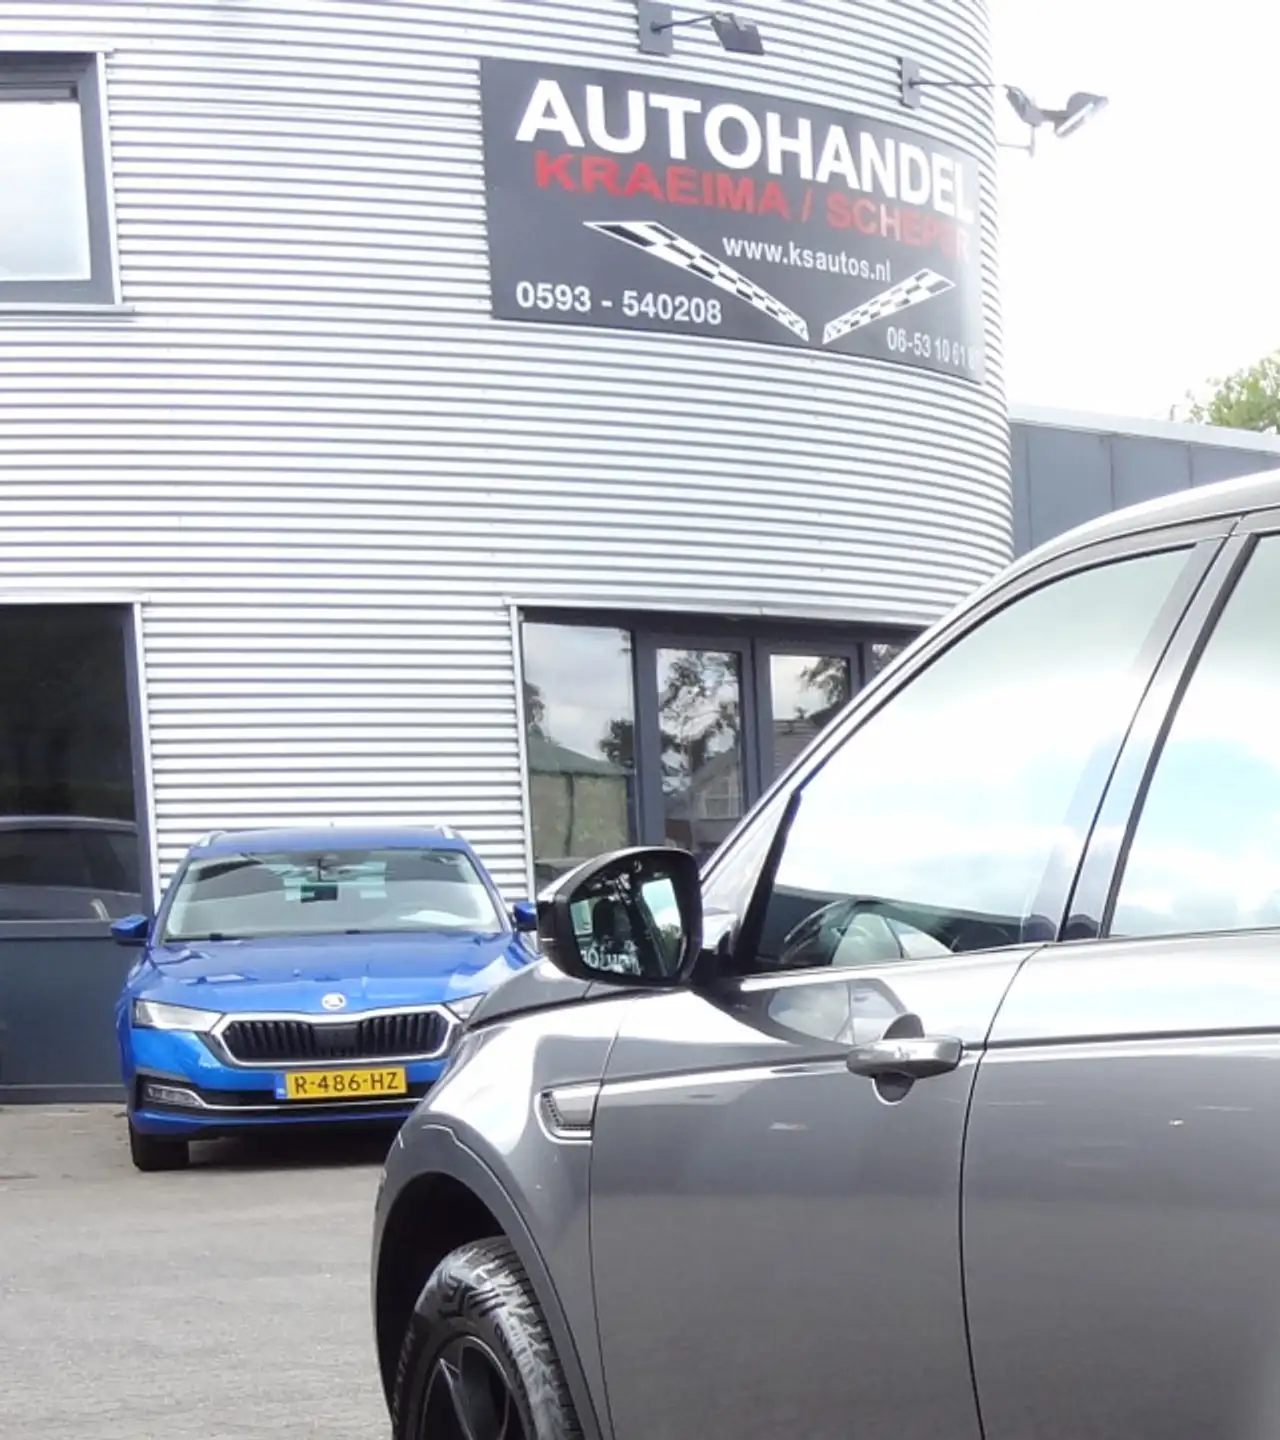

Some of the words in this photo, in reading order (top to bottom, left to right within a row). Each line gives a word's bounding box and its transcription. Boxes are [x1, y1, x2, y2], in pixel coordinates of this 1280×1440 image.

[515, 79, 974, 225] AUTOHANDEL
[534, 149, 790, 223] KRAEIMA
[802, 188, 815, 224] /
[722, 237, 892, 284] www.ksautos.nl
[515, 280, 592, 312] 0593
[622, 289, 723, 325] 540208
[886, 325, 932, 358] 06-53
[294, 1071, 400, 1095] R-486-HZ
